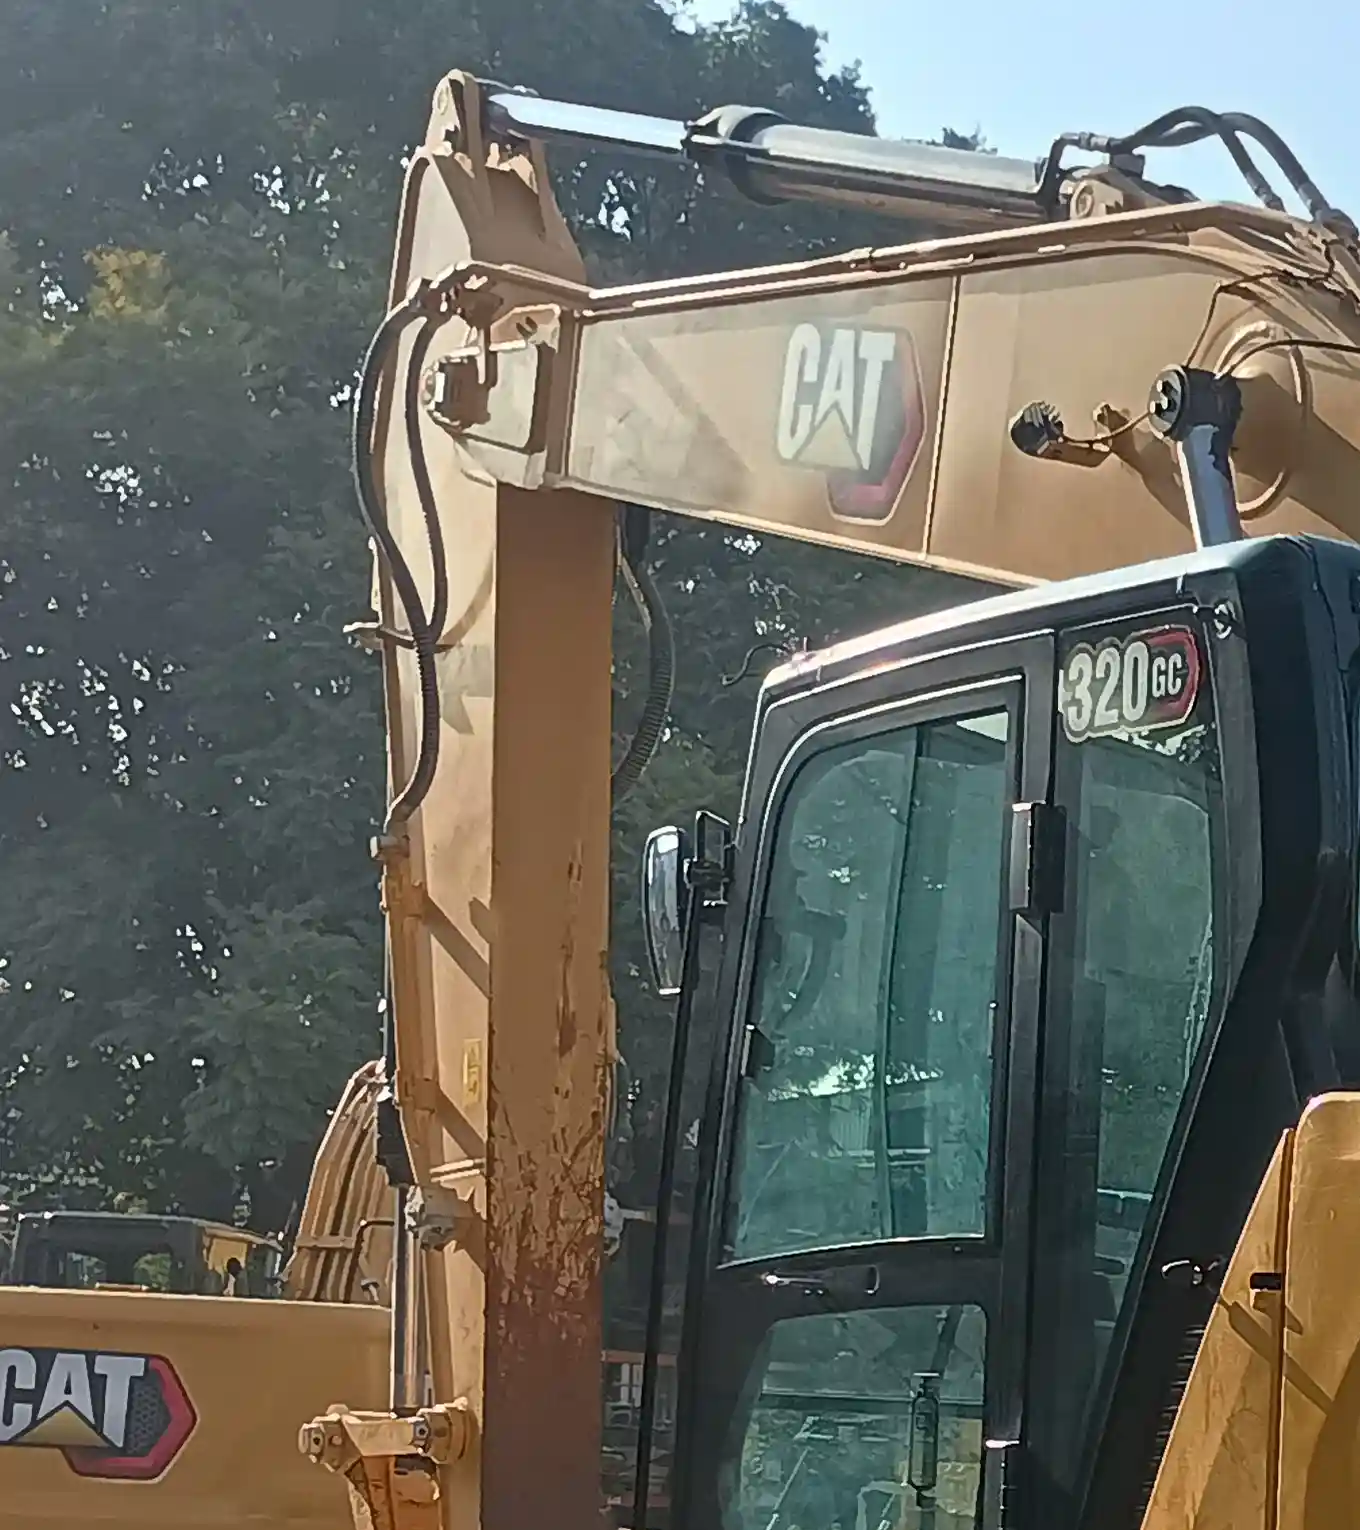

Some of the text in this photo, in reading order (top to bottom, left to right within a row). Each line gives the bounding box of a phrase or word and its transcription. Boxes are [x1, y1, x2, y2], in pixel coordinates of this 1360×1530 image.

[777, 323, 896, 470] CAT
[1067, 640, 1183, 732] 320 GC
[0, 1348, 146, 1448] CAT
